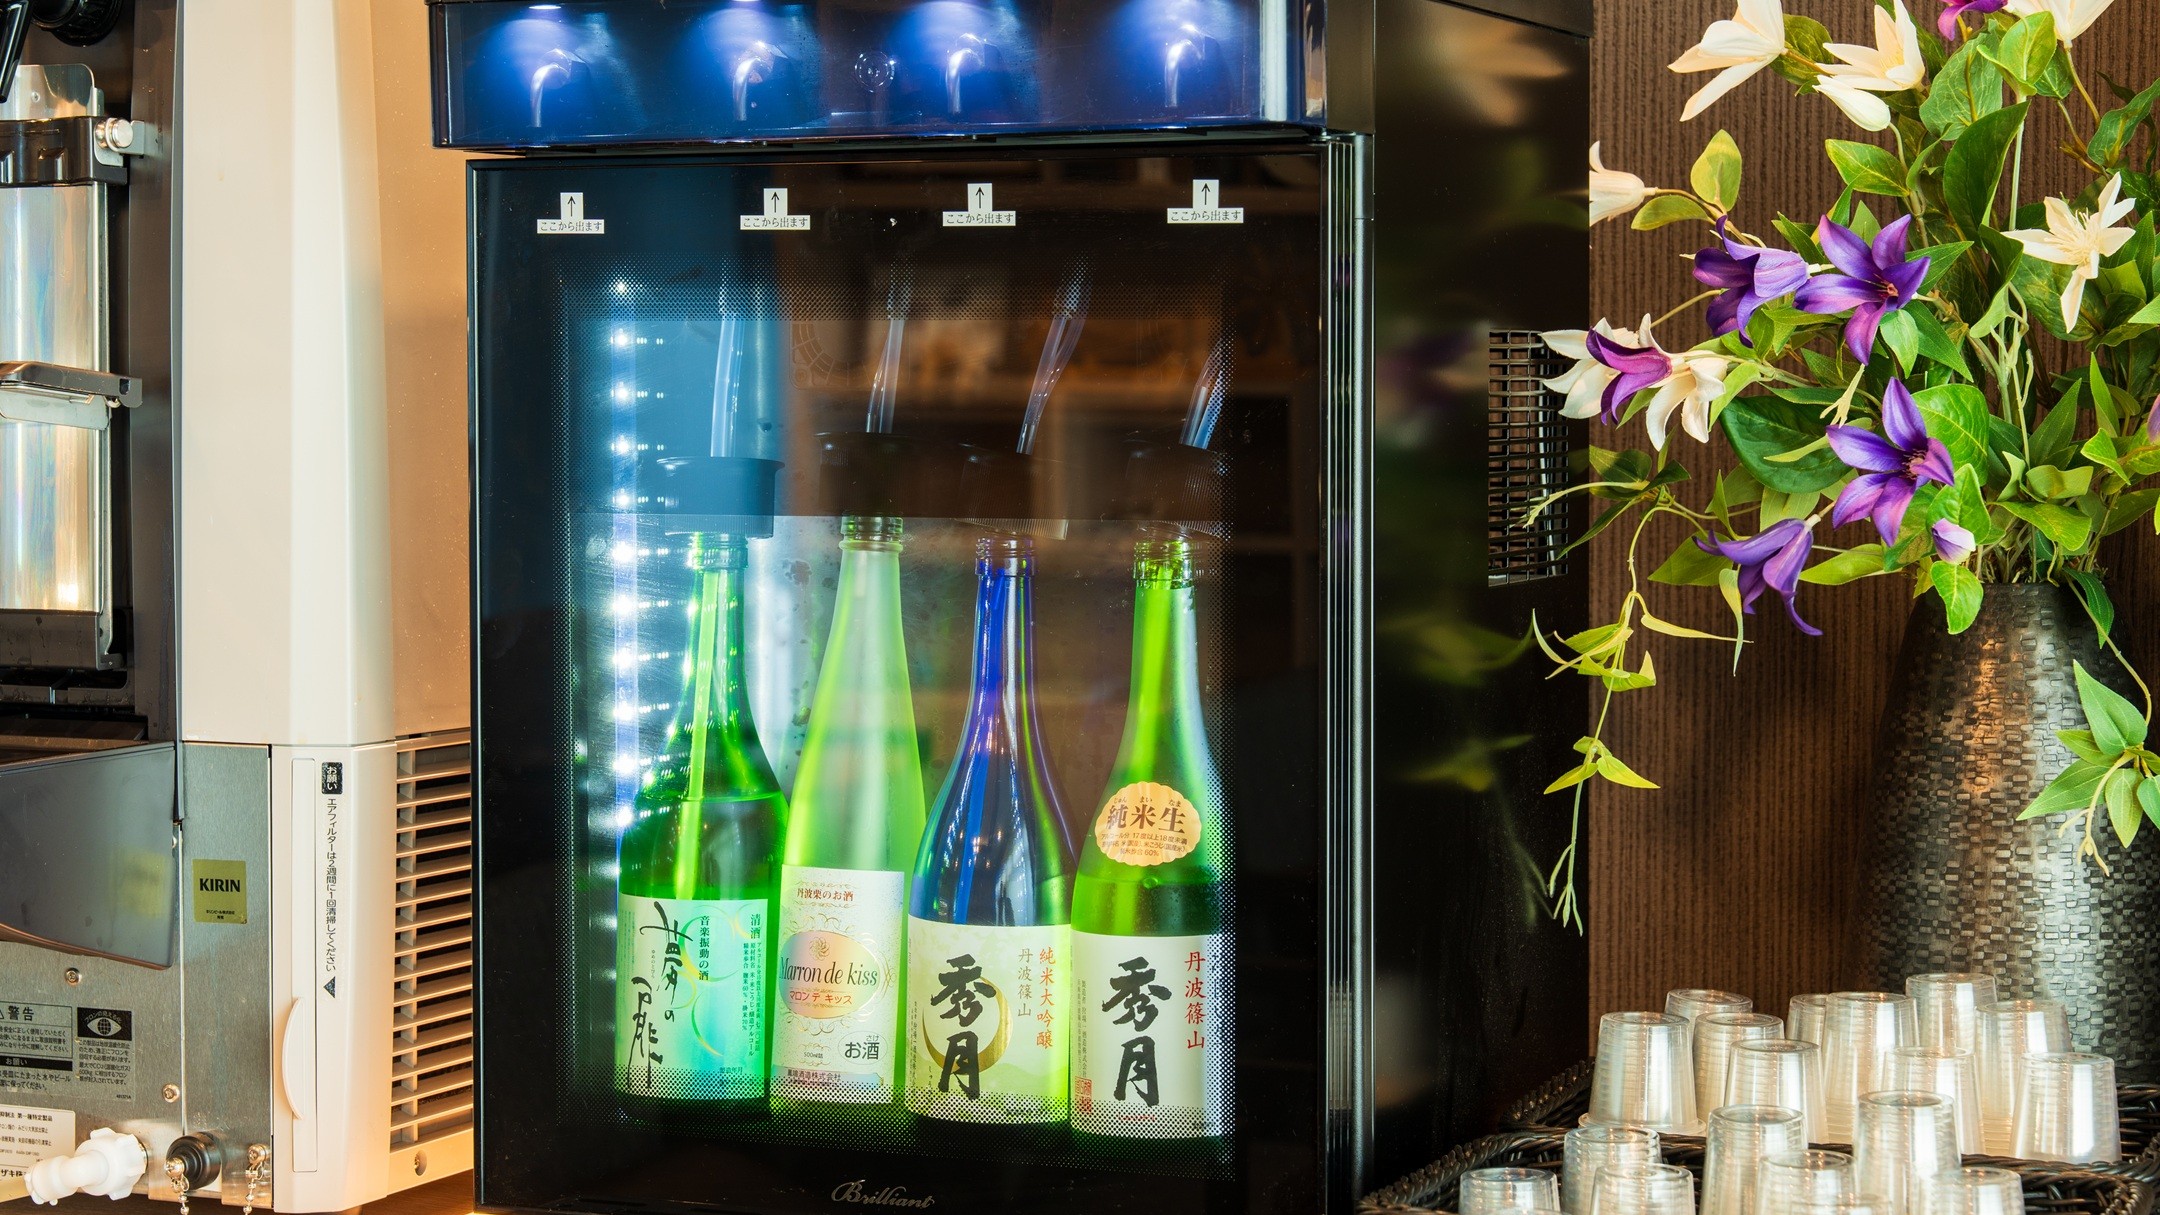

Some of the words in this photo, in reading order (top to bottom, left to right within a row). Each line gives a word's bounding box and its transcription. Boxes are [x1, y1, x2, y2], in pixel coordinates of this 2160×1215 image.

[743, 216, 809, 229] ここから出ます
[946, 212, 1014, 225] ここから出ます
[1170, 209, 1242, 222] ここから出ます
[540, 221, 603, 233] ここから出ます
[326, 765, 338, 791] お願い
[1169, 799, 1182, 808] なま
[1106, 804, 1186, 834] 純米生
[199, 878, 241, 893] KIRIN
[326, 798, 338, 972] エアフィルターは2週間に1回清掃してください
[751, 914, 761, 939] 清酒
[698, 915, 710, 981] 音楽振動の酒
[779, 956, 822, 983] Marron
[824, 961, 844, 985] de
[847, 963, 878, 986] kiss
[1017, 948, 1033, 1018] 丹波篠山
[789, 990, 810, 1002] マロン
[825, 994, 853, 1005] キッス
[1036, 946, 1056, 1050] 純米大吟醸
[1184, 951, 1206, 1050] 丹波篠山
[8, 1005, 34, 1021] 警告
[930, 953, 997, 1100] 秀月
[1101, 956, 1172, 1107] 秀月
[866, 1034, 880, 1042] さけ
[5, 1057, 28, 1066] お願い
[844, 1041, 880, 1060] お酒
[1, 1169, 26, 1178] ザキ株
[831, 1179, 935, 1209] Brilliant
